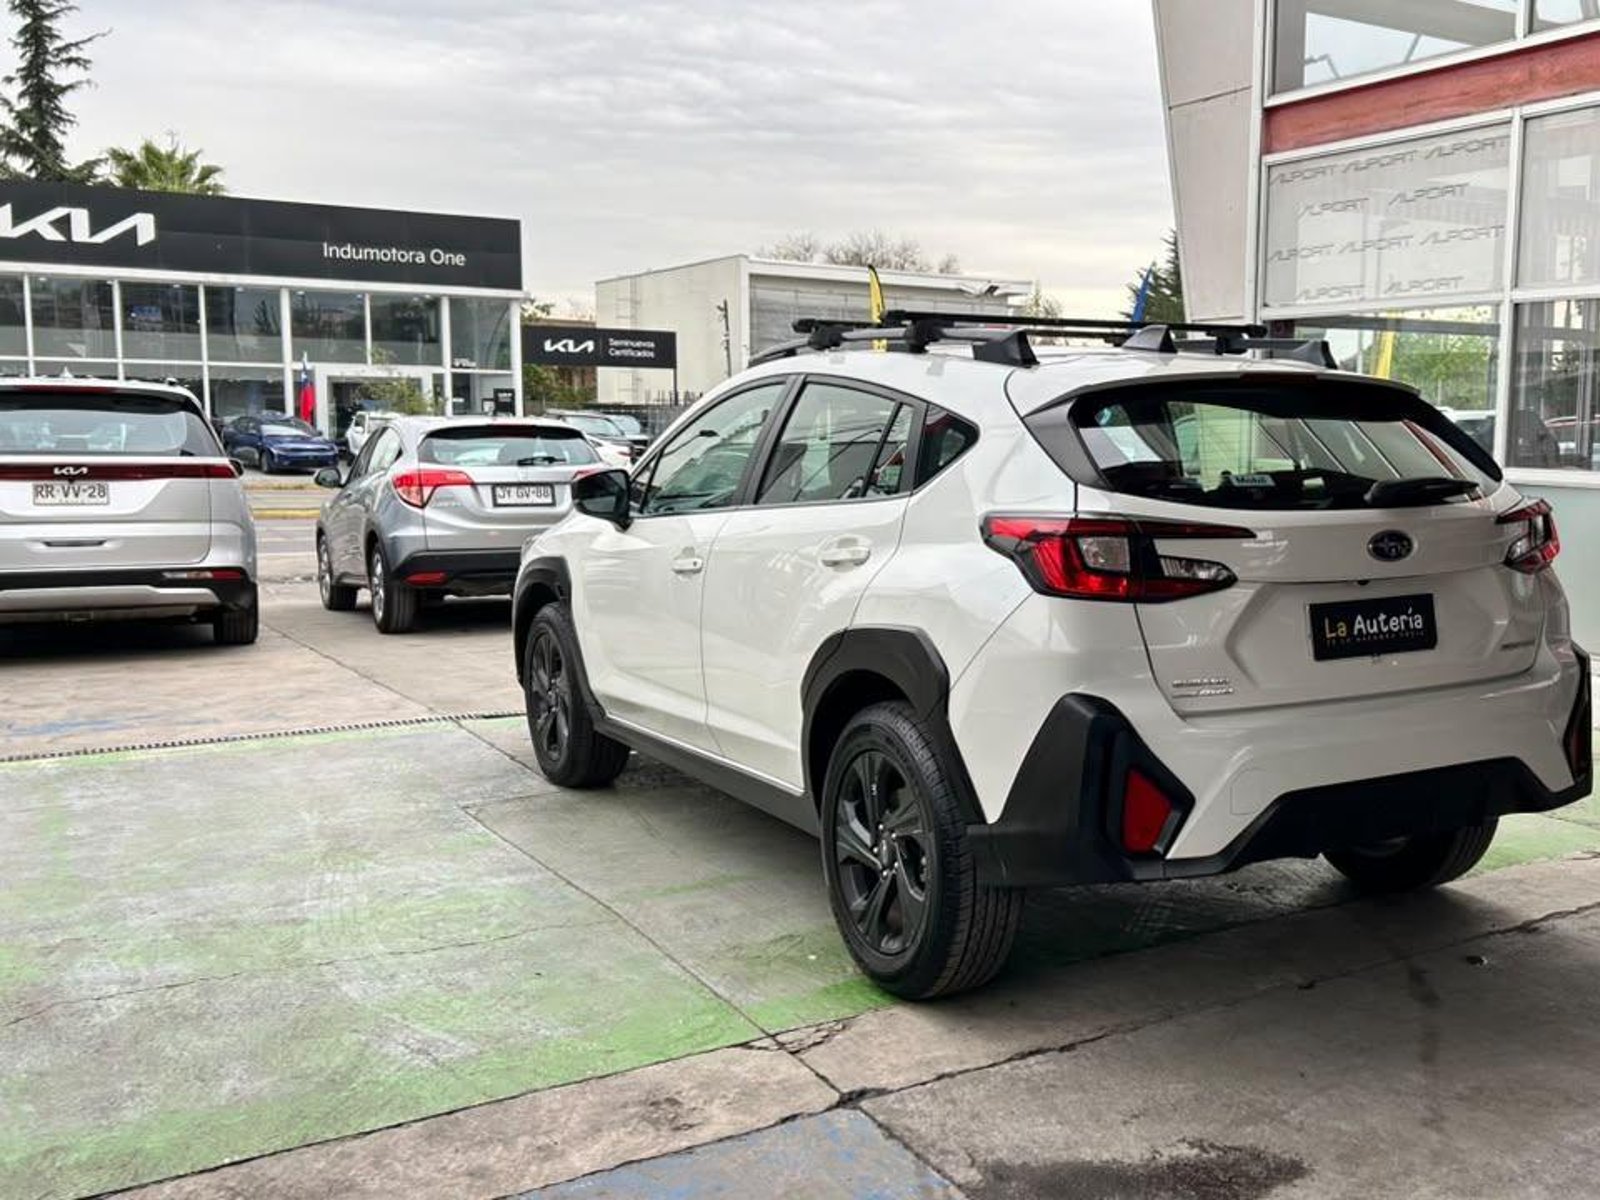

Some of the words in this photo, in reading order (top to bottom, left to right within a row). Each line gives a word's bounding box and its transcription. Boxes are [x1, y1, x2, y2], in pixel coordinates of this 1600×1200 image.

[322, 241, 426, 264] Indumotora
[429, 248, 467, 266] One
[544, 337, 595, 353] KIA
[1324, 617, 1347, 638] La
[1353, 606, 1423, 635] Autería
